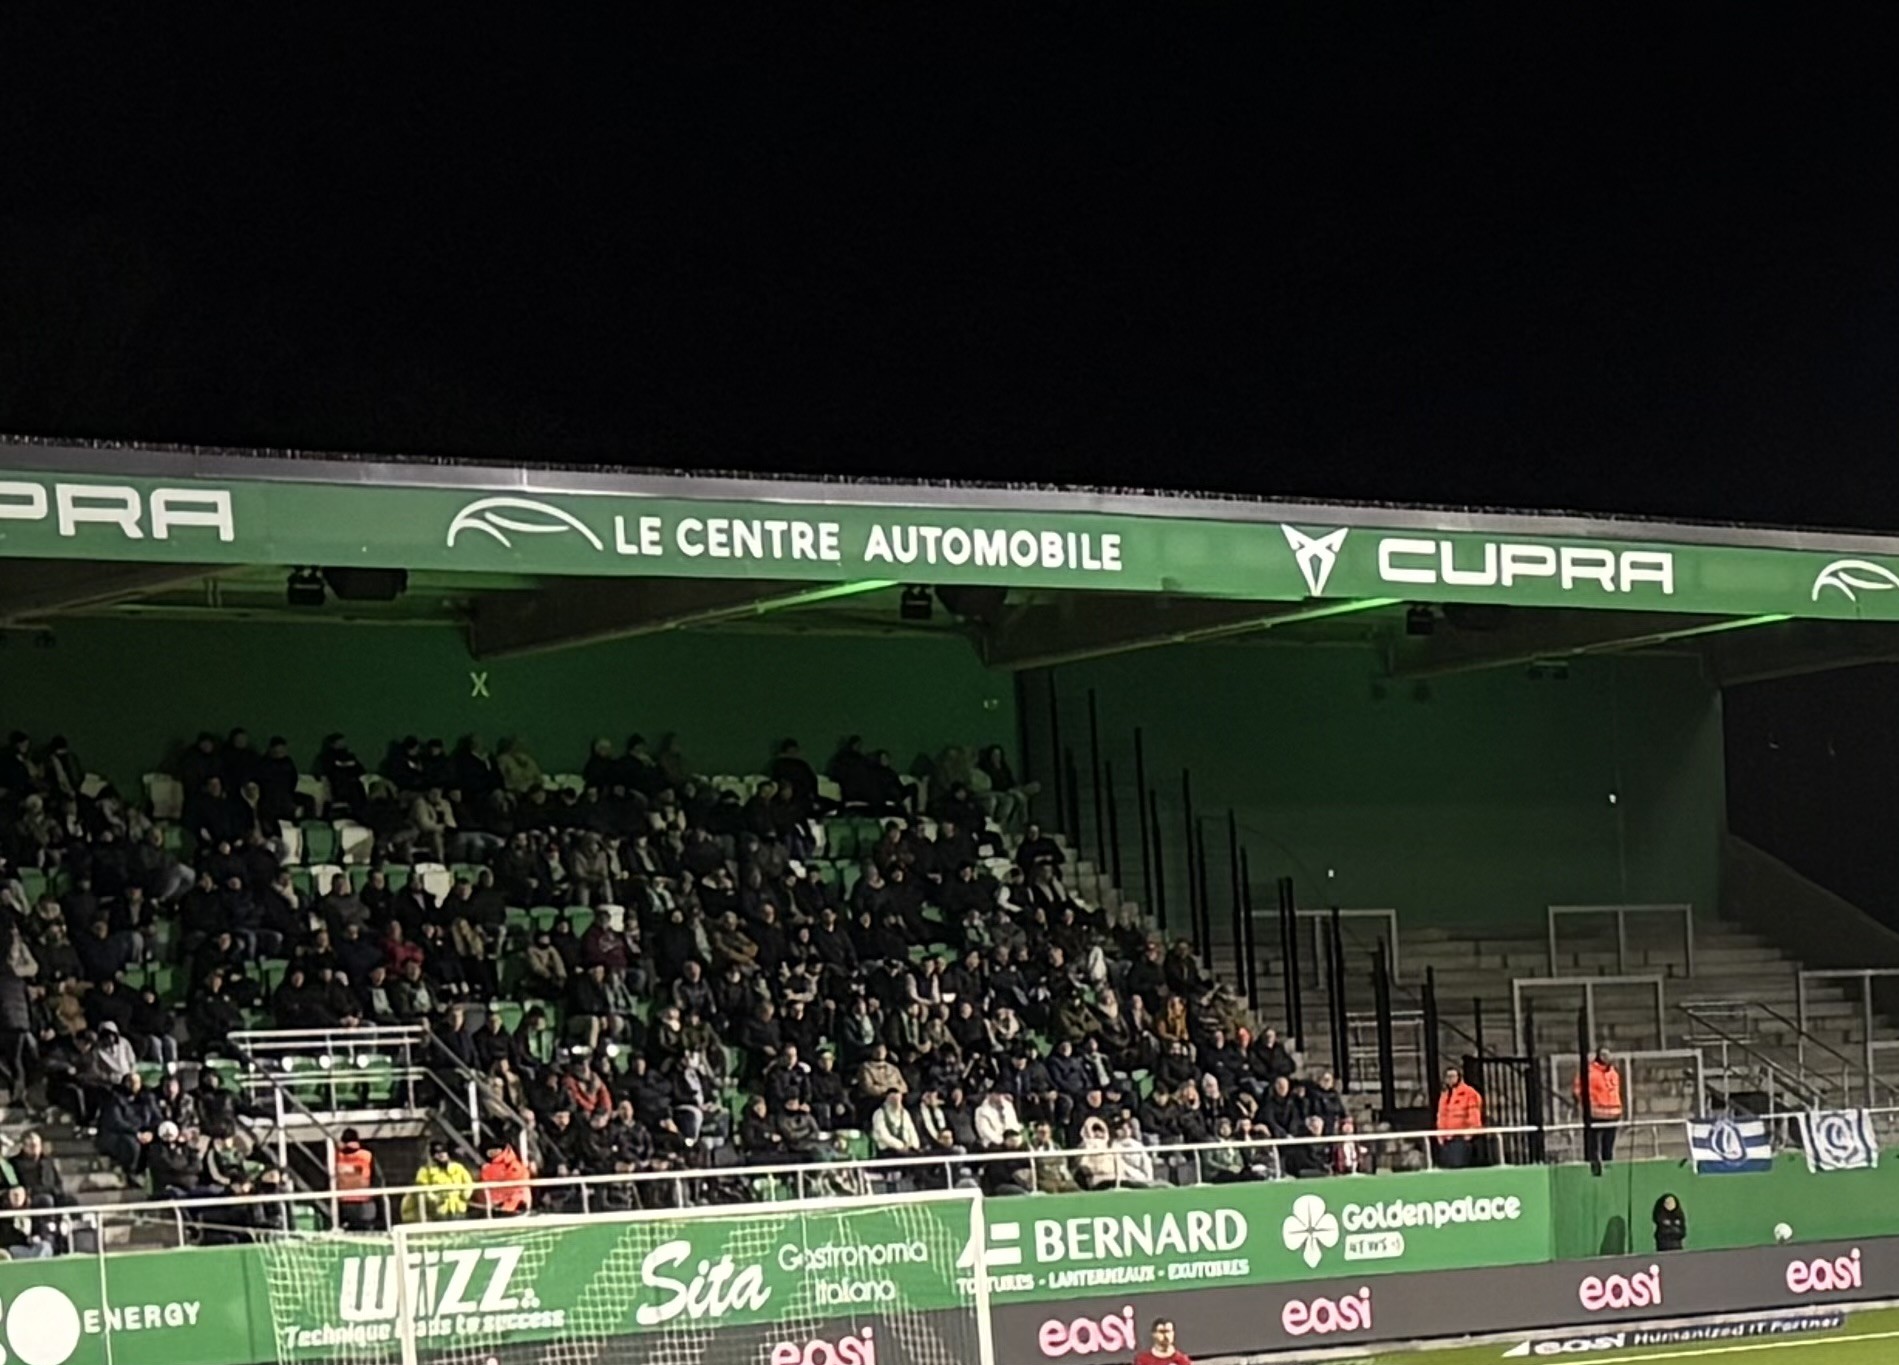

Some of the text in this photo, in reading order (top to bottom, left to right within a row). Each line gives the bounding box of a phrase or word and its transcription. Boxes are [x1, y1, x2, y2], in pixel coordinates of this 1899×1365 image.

[614, 515, 1123, 571] LE CENTRE AUTOMOBILE
[1377, 537, 1675, 595] CUPRA
[1035, 1208, 1248, 1264] BERNARD
[1342, 1194, 1522, 1233] Goldenpalace
[635, 1239, 772, 1325] Sita
[958, 1258, 1250, 1293] TOTURES LANTERNEAUX EXUTOIRES
[1579, 1264, 1662, 1312] easi
[1786, 1248, 1862, 1295] easi
[84, 1301, 201, 1335] ENERGY
[283, 1322, 391, 1349] Technique
[394, 1316, 450, 1340] lads
[1038, 1305, 1137, 1359] easi
[1281, 1286, 1373, 1337] easi
[1534, 1316, 1841, 1356] easi Humanized IT Partner
